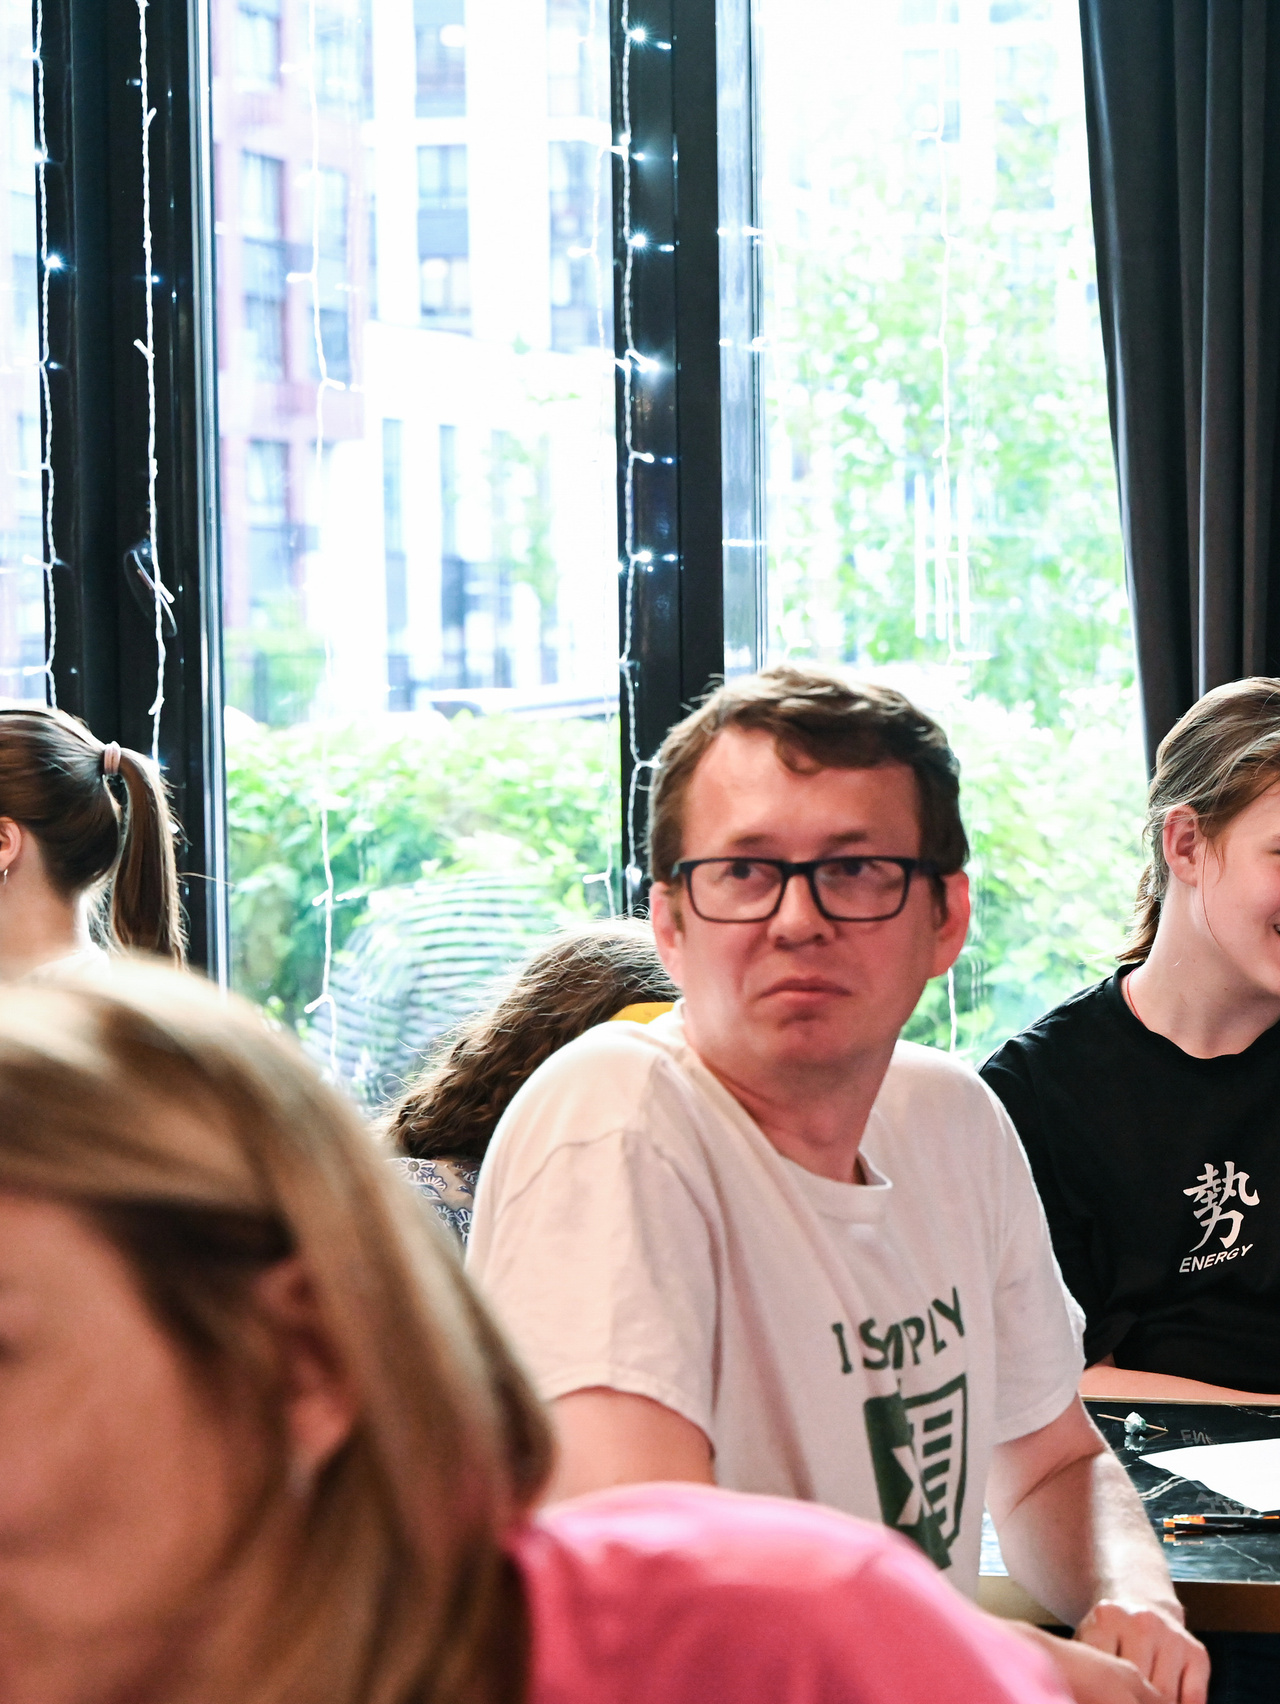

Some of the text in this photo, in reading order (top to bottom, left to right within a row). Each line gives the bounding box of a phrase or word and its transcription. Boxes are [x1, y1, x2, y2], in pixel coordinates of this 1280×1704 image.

[1183, 1161, 1260, 1253] 勢
[1179, 1244, 1254, 1273] ENERGY
[831, 1322, 853, 1374] I
